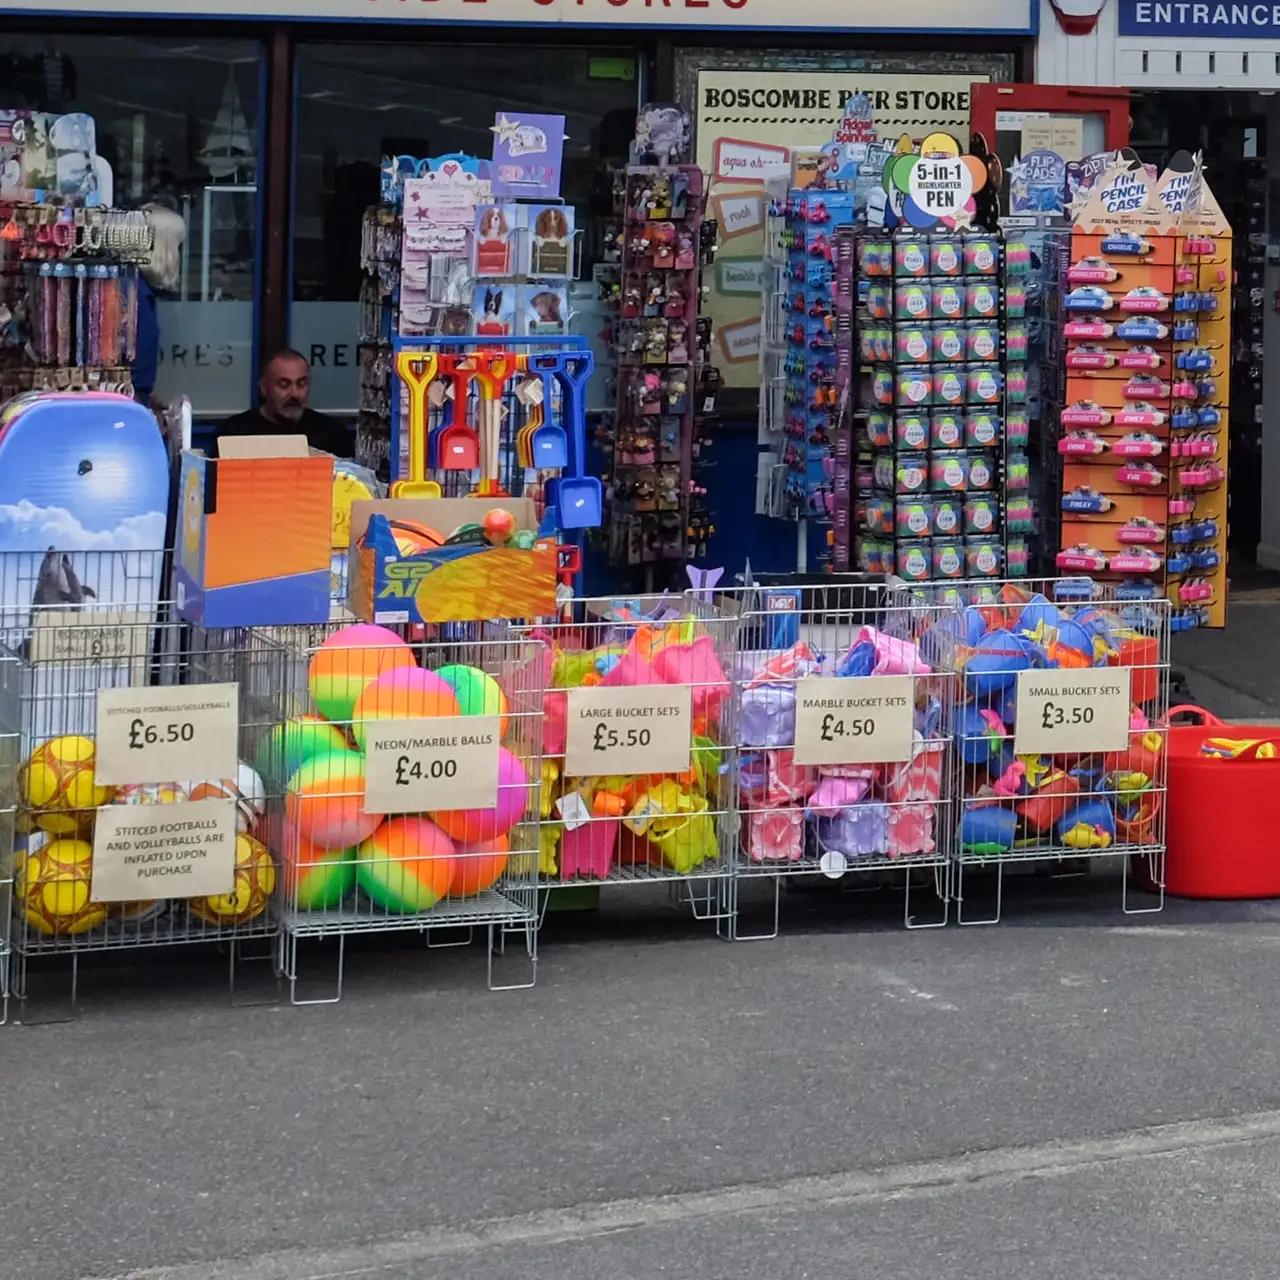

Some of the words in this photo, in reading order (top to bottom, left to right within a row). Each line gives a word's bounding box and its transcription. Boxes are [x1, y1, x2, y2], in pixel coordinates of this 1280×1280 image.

[704, 88, 830, 109] BOSCOMBE
[1030, 155, 1055, 168] FLIP
[917, 164, 962, 181] 5-in-1
[1026, 167, 1056, 180] PADS
[917, 181, 962, 190] HIGHLIGHTER
[1101, 183, 1148, 203] PENCIL
[926, 190, 955, 208] PEN
[1106, 196, 1143, 214] CASE
[1029, 687, 1059, 697] SMALL
[1061, 686, 1097, 696] BUCKET
[1100, 686, 1121, 695] SETS
[580, 708, 613, 718] LARGE
[616, 707, 655, 717] BUCKET
[657, 706, 680, 716] SETS
[802, 698, 844, 709] MARBLE
[846, 698, 882, 708] BUCKET
[884, 697, 907, 707] SETS
[1042, 701, 1094, 729] £3.50
[129, 718, 194, 749] £6.50
[593, 722, 651, 751] £5.50
[821, 713, 875, 742] £4.50
[374, 736, 458, 751] NEON/MARBLE
[460, 734, 493, 746] BALLS
[396, 755, 458, 786] £4.00
[115, 824, 157, 837] STITCED
[160, 819, 218, 833] FOOTBALLS
[106, 840, 131, 851] AND
[134, 836, 202, 850] VOLLEYBALLS
[204, 832, 225, 843] ARE
[124, 853, 173, 865] INFLATED
[176, 848, 207, 861] UPON
[137, 864, 193, 878] PURCHASE
